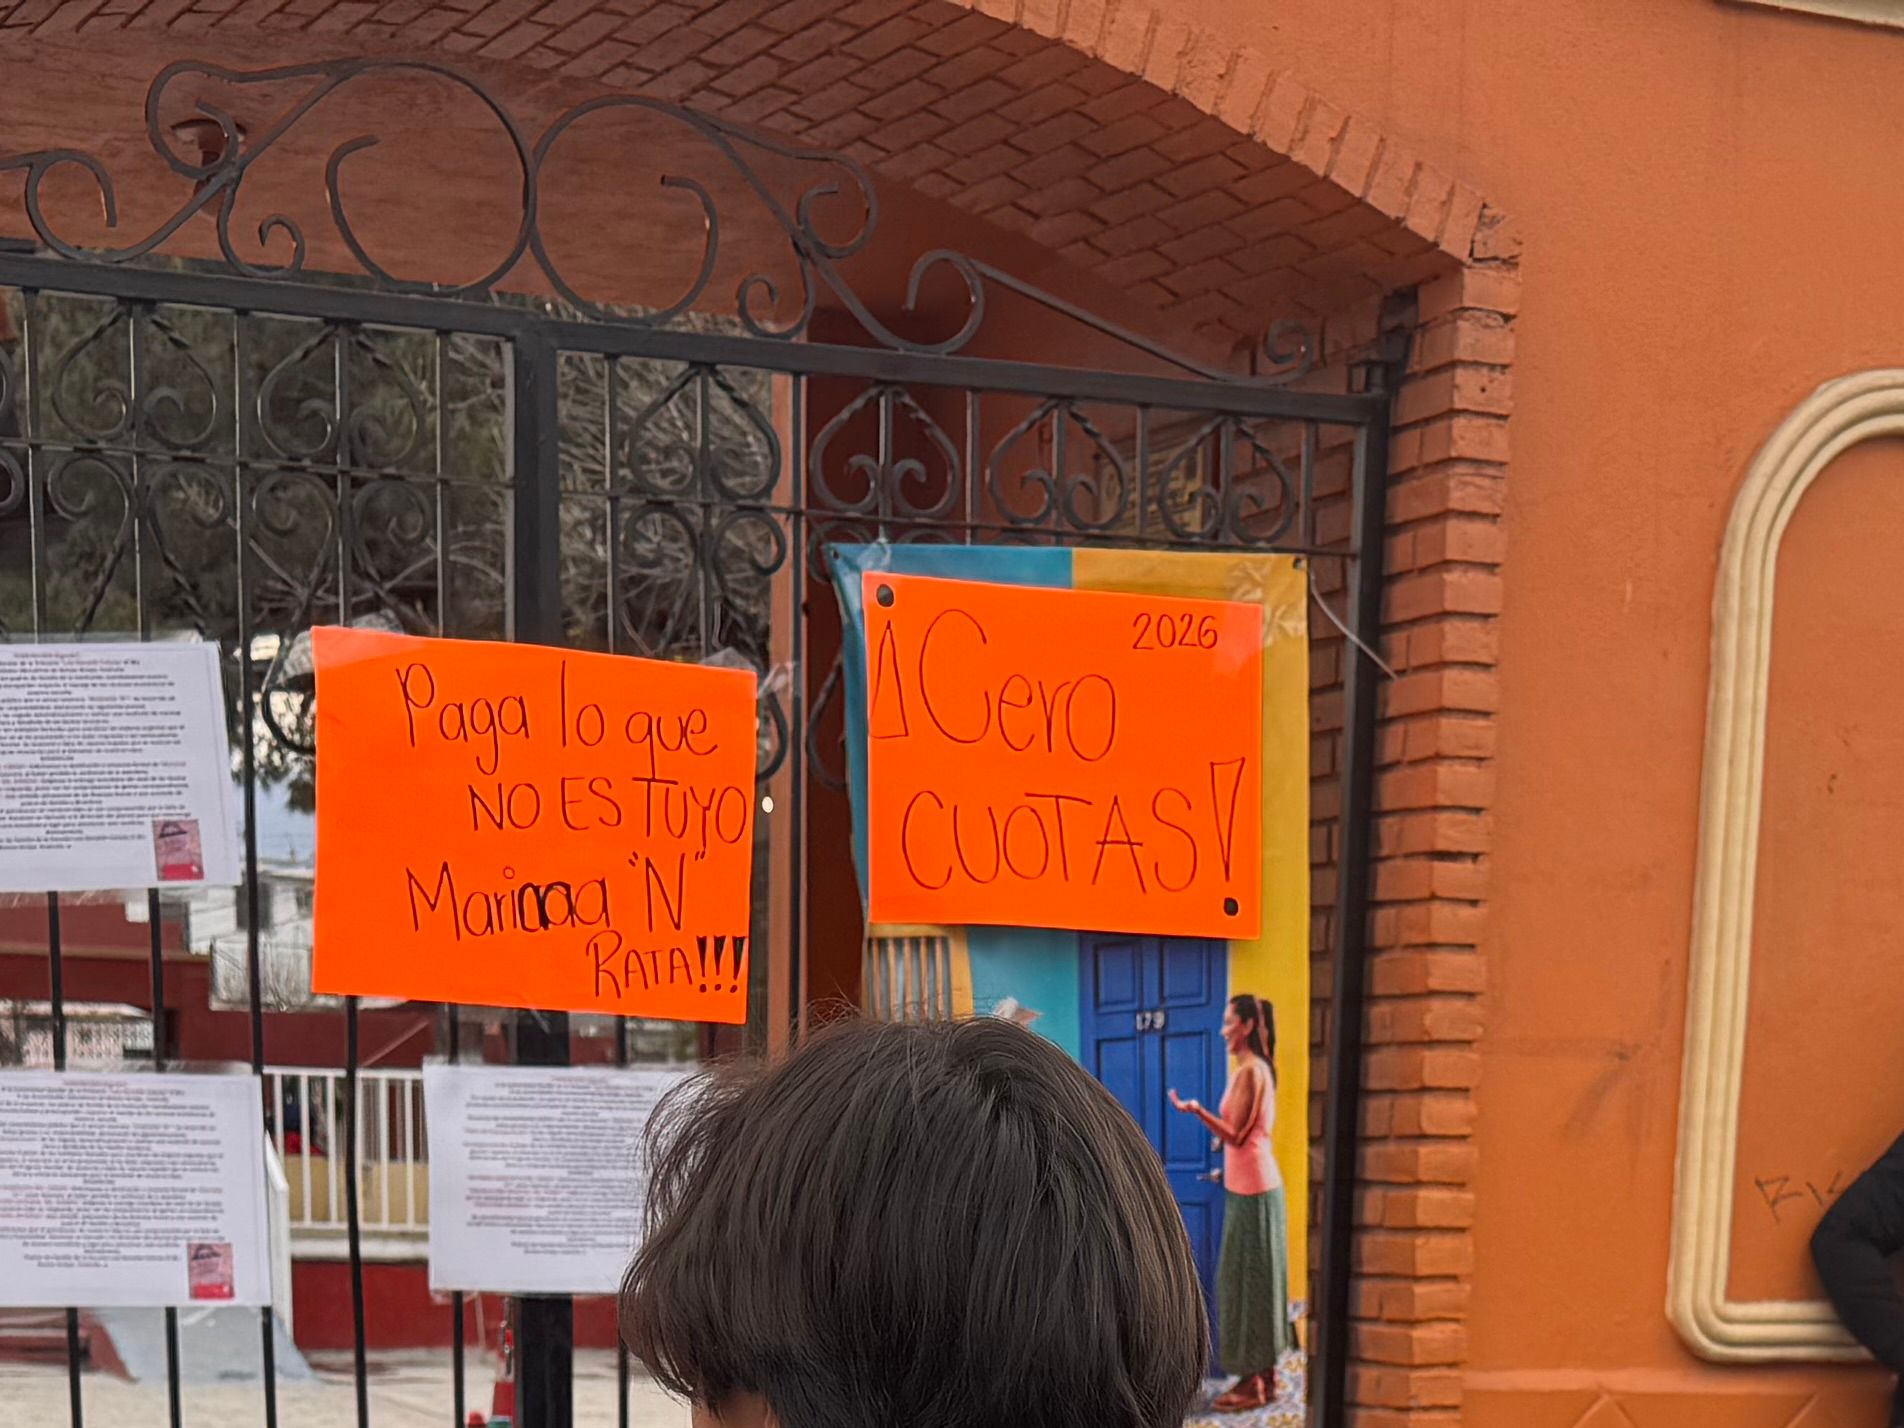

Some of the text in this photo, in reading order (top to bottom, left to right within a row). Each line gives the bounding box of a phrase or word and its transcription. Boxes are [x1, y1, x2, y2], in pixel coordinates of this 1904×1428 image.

[1132, 612, 1218, 650] 2026
[395, 660, 718, 780] Paga lo que
[467, 776, 748, 849] NO ES TUYO
[901, 756, 1245, 917] CUOTAS!
[585, 930, 748, 999] RATA!!!
